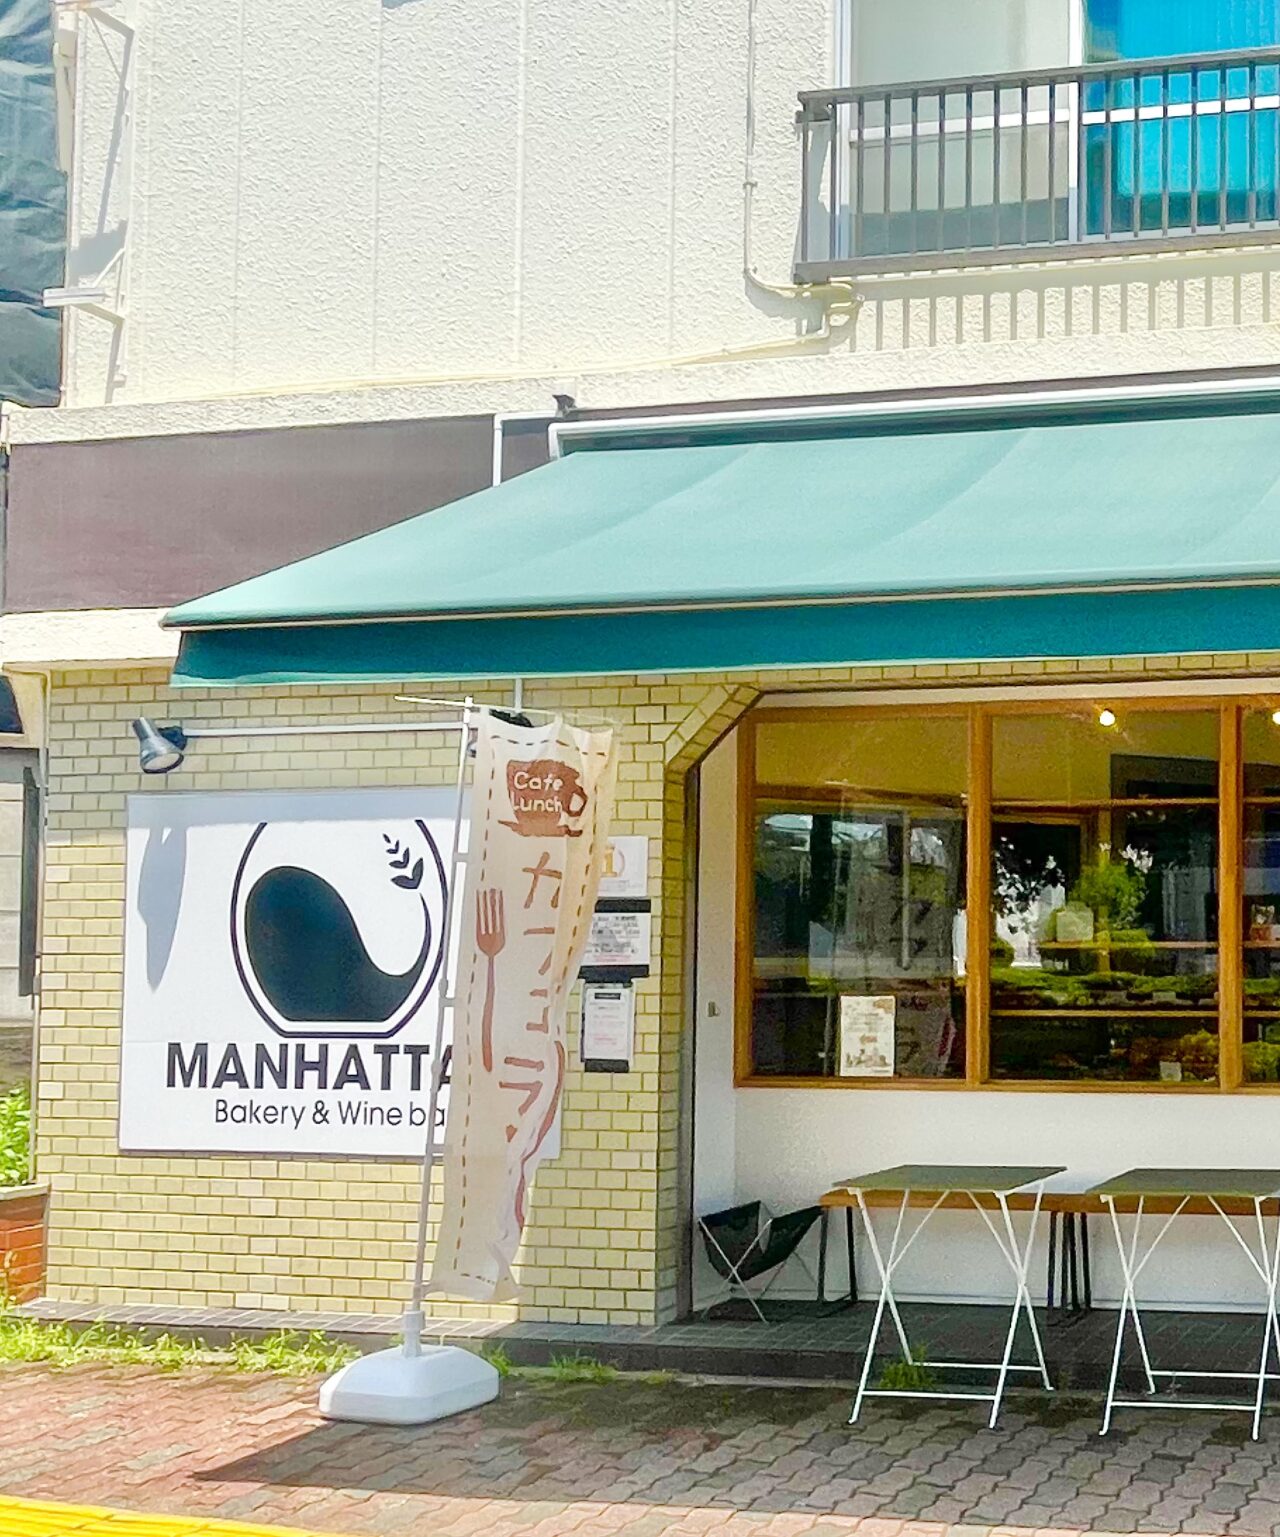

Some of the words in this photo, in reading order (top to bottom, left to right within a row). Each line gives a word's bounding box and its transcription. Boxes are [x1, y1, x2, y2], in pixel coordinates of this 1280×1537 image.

[513, 771, 563, 792] Cafe
[512, 797, 563, 812] Lunch
[214, 1099, 305, 1130] Bakery
[312, 1100, 330, 1125] &
[337, 1101, 403, 1126] Wine
